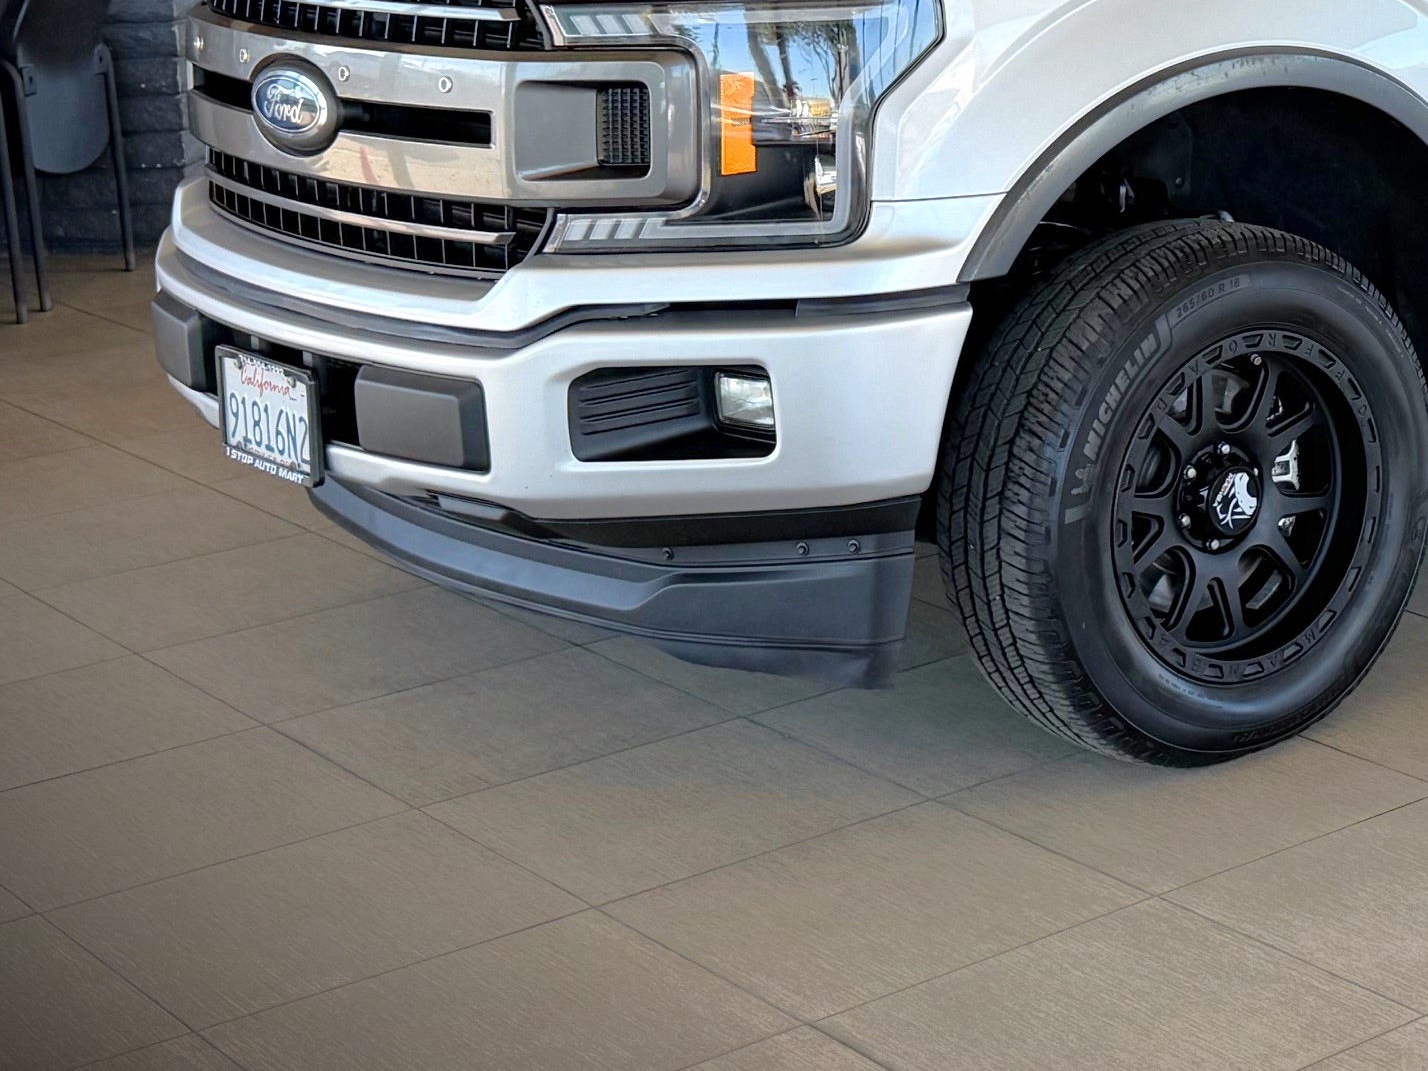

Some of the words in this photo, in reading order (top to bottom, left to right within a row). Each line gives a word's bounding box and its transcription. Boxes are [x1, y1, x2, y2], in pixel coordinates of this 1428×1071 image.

[263, 83, 304, 124] Ford
[1218, 282, 1225, 294] R
[241, 366, 297, 401] California
[1083, 333, 1157, 461] MICHELIN
[229, 392, 310, 465] 91816N2
[230, 450, 254, 465] STOP
[254, 459, 277, 475] AUTO
[278, 468, 304, 484] MART
